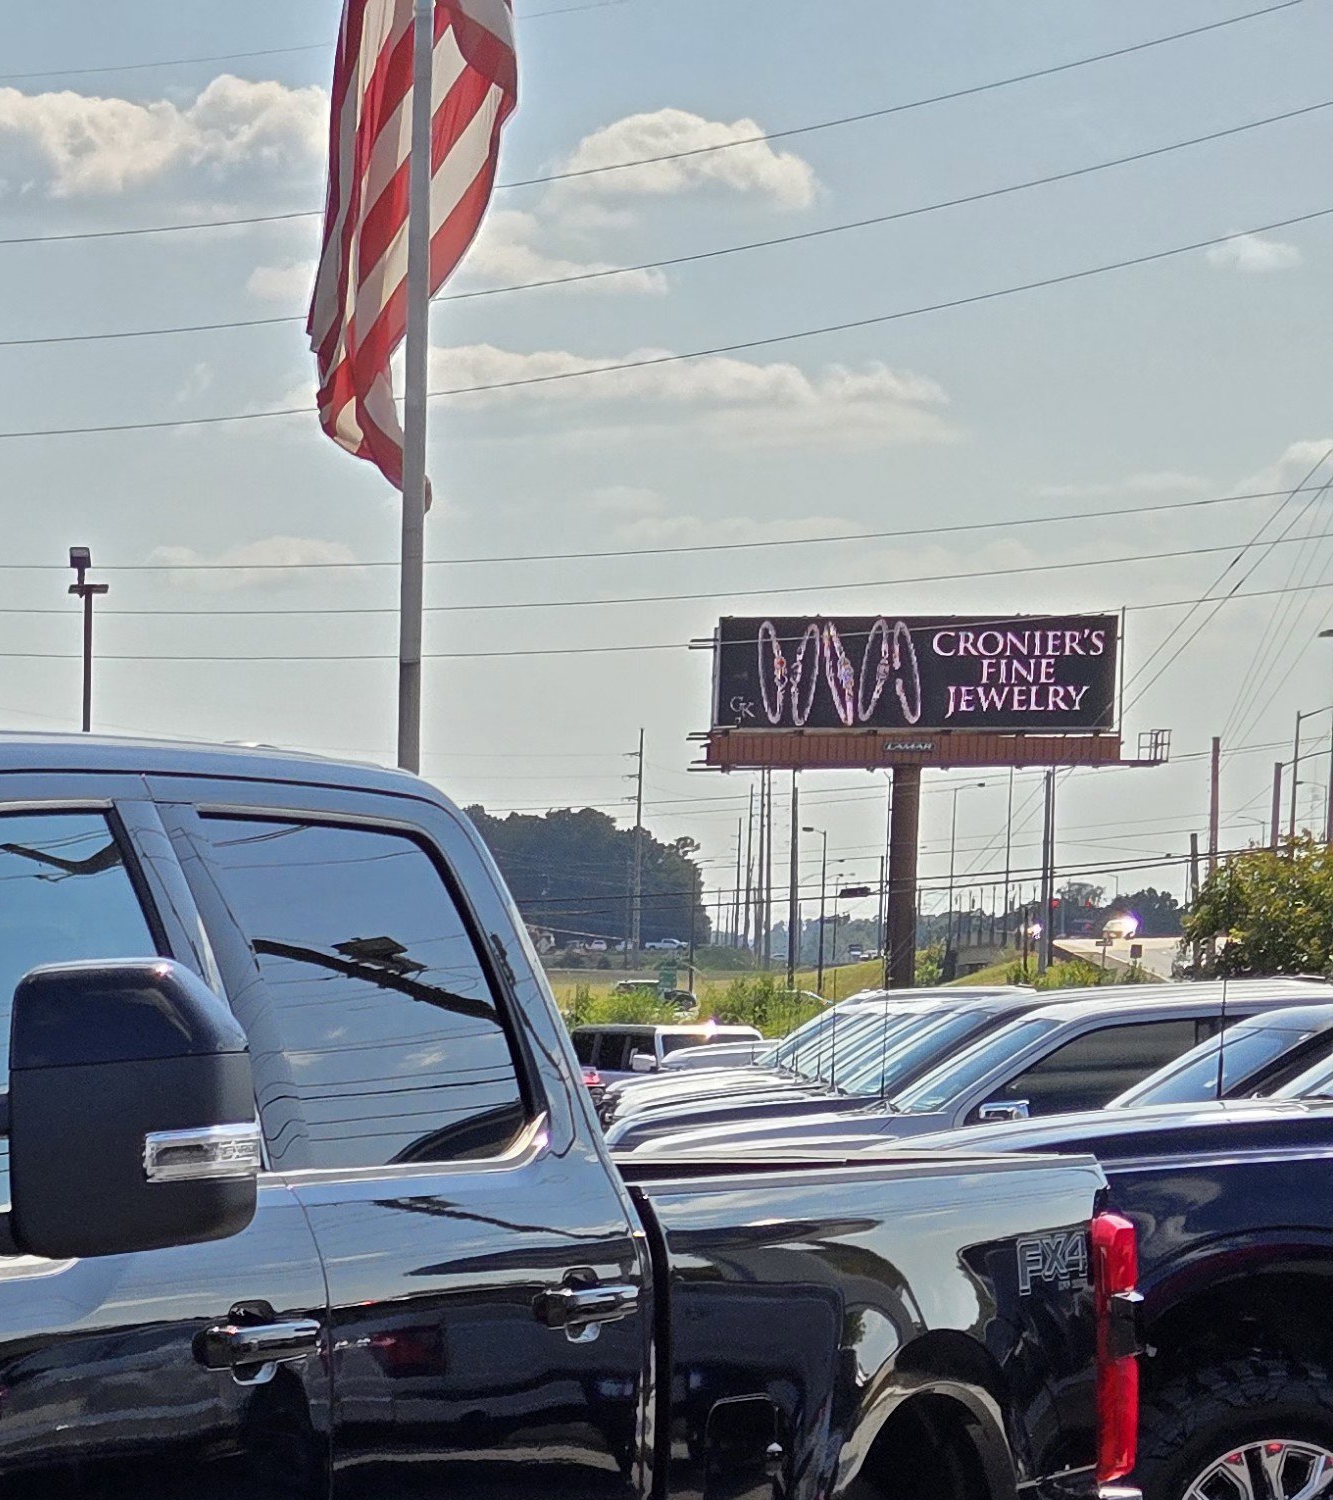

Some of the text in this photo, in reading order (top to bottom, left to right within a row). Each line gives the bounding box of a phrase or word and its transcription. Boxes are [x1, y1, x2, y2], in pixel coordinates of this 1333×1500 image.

[932, 629, 1105, 657] CRONIER'S
[981, 659, 1055, 684] FINE
[945, 686, 1090, 718] JEWELRY
[886, 742, 933, 751] LAMAR
[1016, 1229, 1088, 1296] FX4
